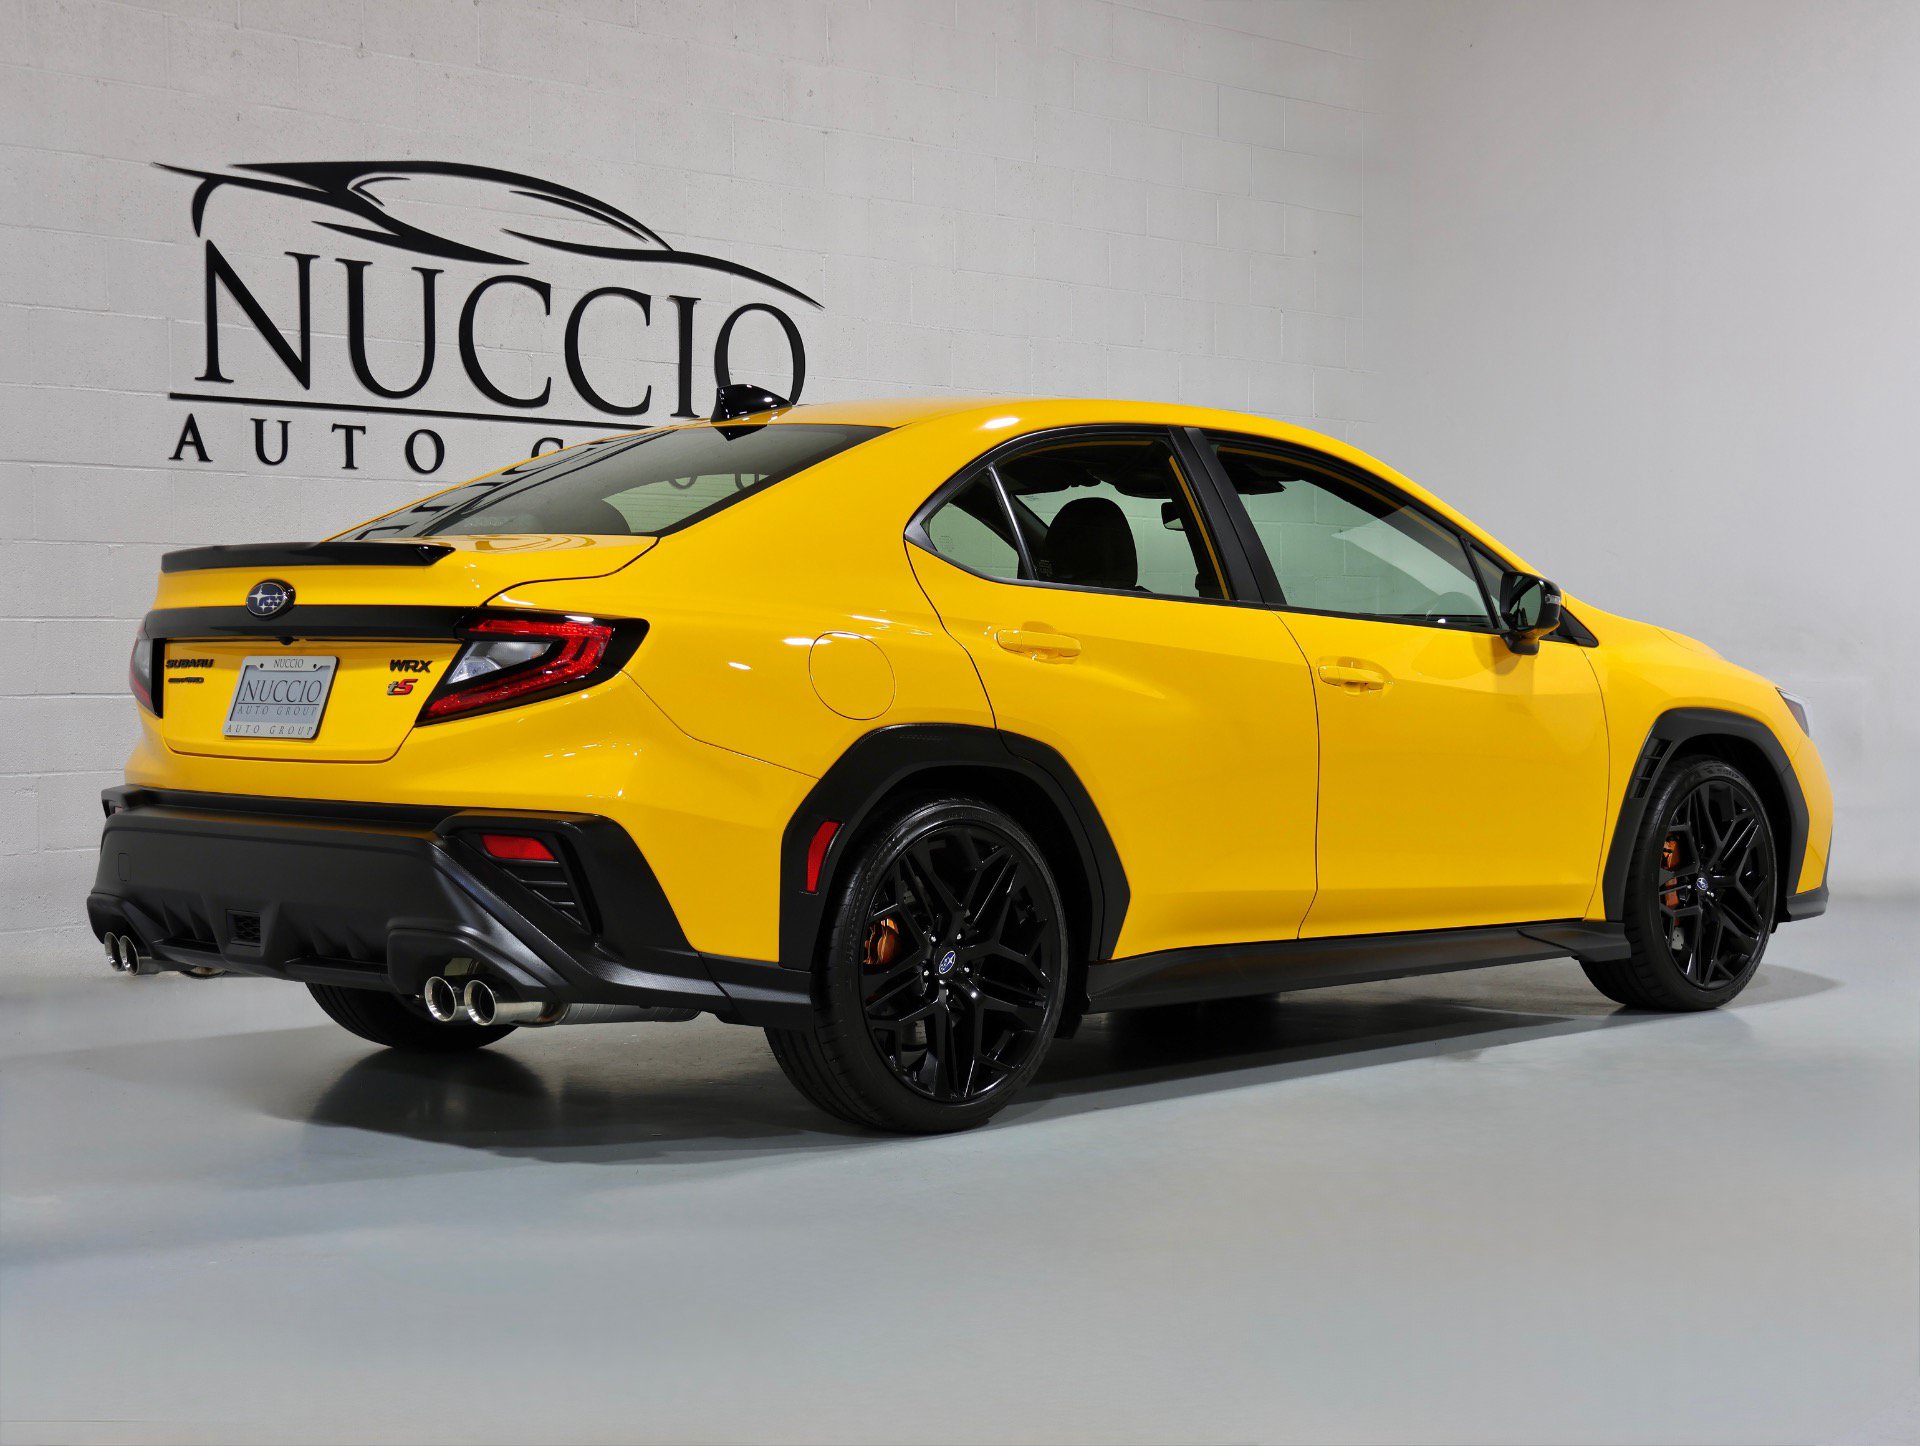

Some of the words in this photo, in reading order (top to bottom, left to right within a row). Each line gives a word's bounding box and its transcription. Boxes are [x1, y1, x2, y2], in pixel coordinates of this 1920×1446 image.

[195, 238, 806, 418] NUCCIO
[168, 413, 446, 475] AUTO
[165, 658, 215, 669] SUBARU
[273, 658, 304, 669] NUCCIO
[389, 659, 433, 673] WRX
[242, 679, 322, 703] NUCCIO
[237, 705, 269, 715] AUTO
[276, 706, 317, 716] GROUP
[225, 724, 260, 734] AUTO
[269, 725, 313, 736] GROUP
